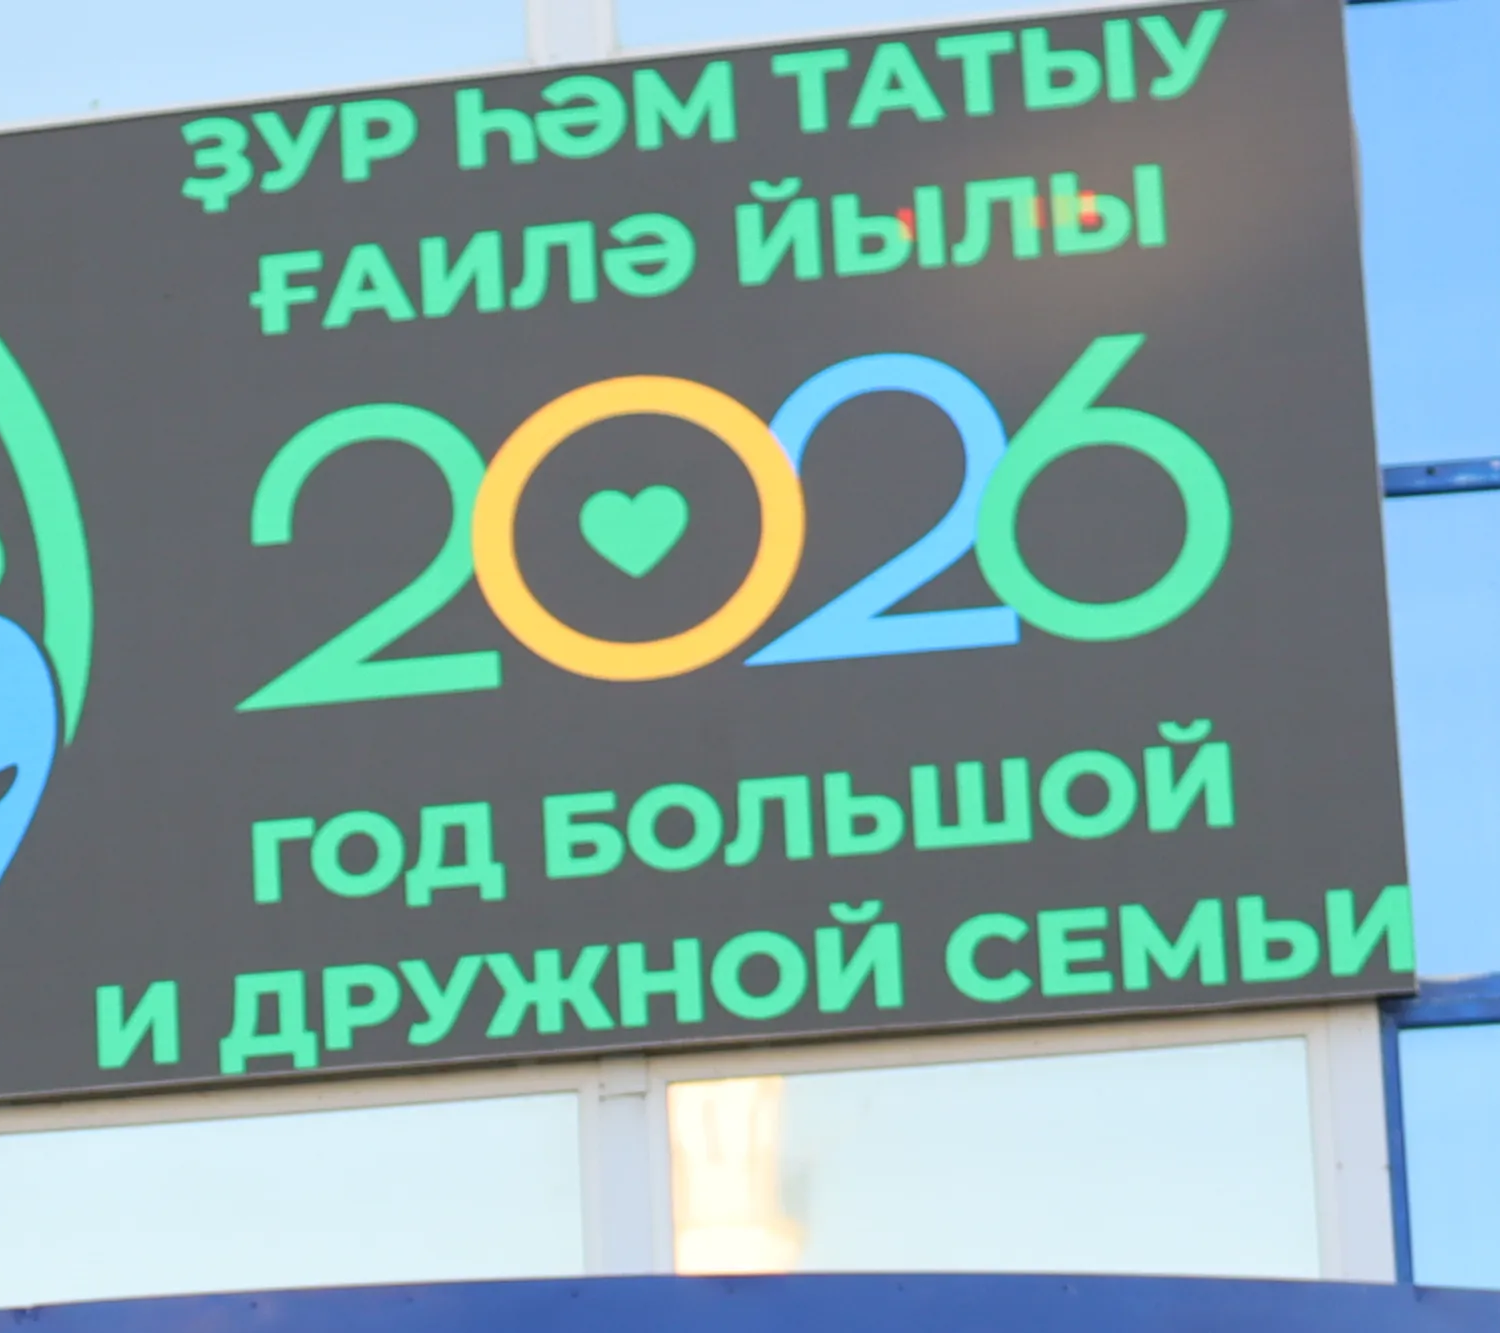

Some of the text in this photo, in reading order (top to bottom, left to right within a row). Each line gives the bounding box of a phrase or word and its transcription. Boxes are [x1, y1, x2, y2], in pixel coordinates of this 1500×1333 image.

[771, 9, 1228, 133] ТАТЫУ
[735, 164, 1168, 286] ЙЫЛЫ
[235, 331, 1234, 712] 2026
[250, 717, 1237, 908] ГОД БОЛЬШОЙ
[95, 884, 1416, 1076] И ДРУЖНОЙ СЕМЬИ
